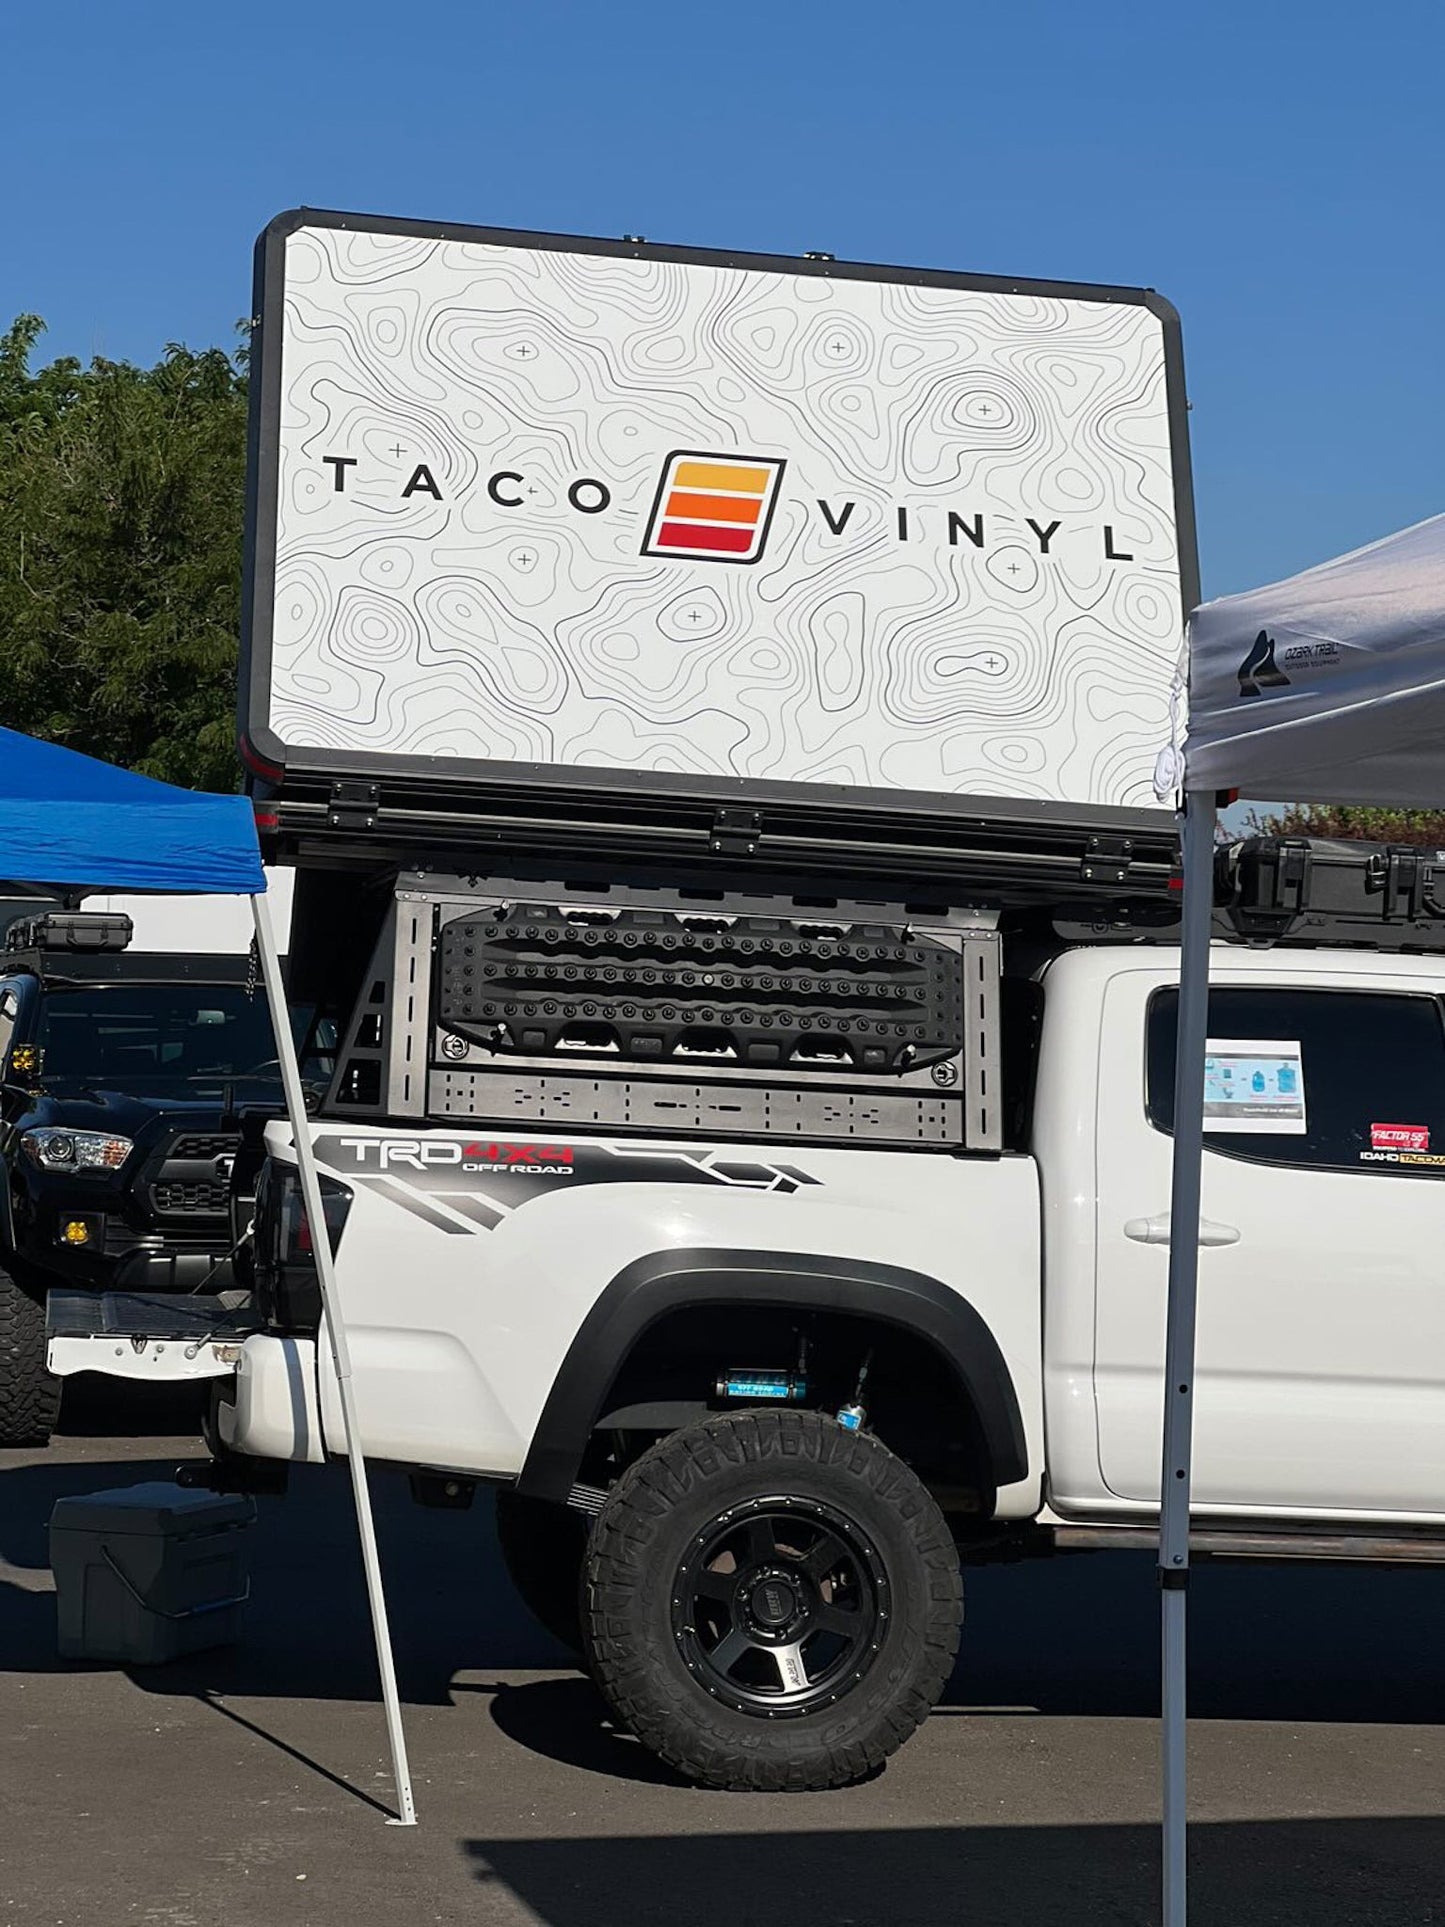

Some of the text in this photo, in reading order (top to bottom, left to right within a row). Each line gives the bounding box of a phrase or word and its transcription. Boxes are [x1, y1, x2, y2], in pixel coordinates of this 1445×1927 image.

[323, 456, 1133, 562] TACO VINYL
[1373, 1131, 1425, 1142] FACTOR 55
[341, 1138, 574, 1170] TRD 4X4
[1360, 1152, 1398, 1161] IDAHO
[462, 1163, 574, 1175] OFF ROAD
